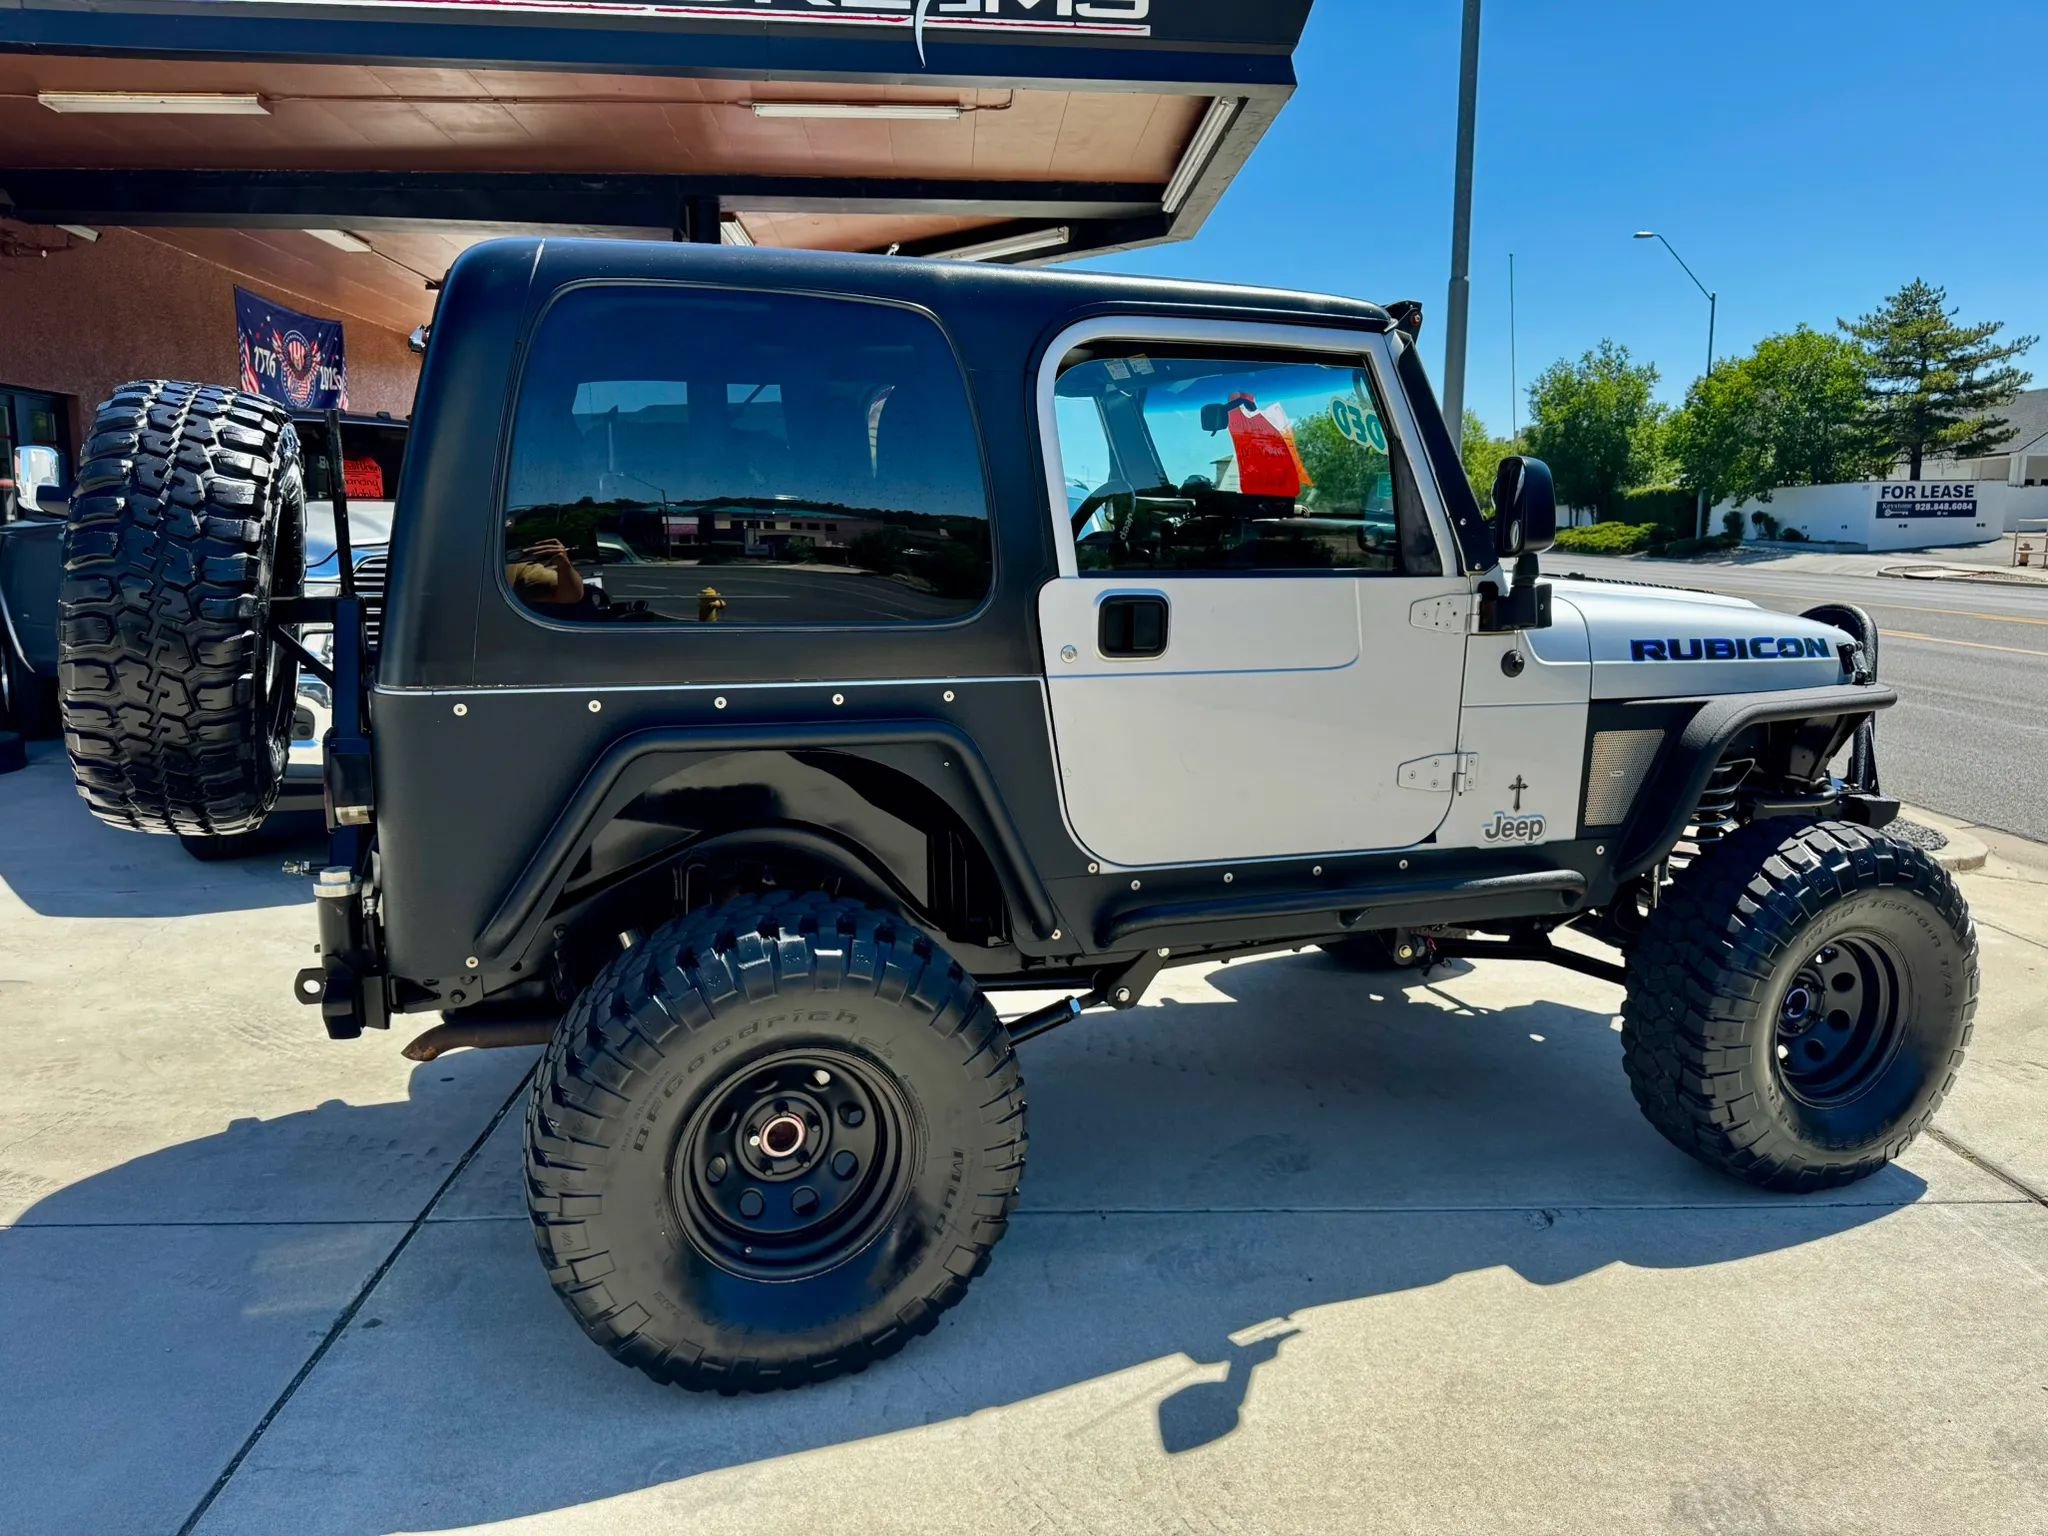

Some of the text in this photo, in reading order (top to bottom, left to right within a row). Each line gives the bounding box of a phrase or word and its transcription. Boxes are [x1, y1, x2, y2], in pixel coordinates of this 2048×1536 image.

[254, 345, 276, 379] 1776
[1881, 485, 1917, 499] FOR
[1920, 484, 1976, 499] LEASE
[1119, 512, 1134, 540] Jeep
[1631, 637, 1831, 662] RUBICON
[1484, 814, 1545, 842] Jeep
